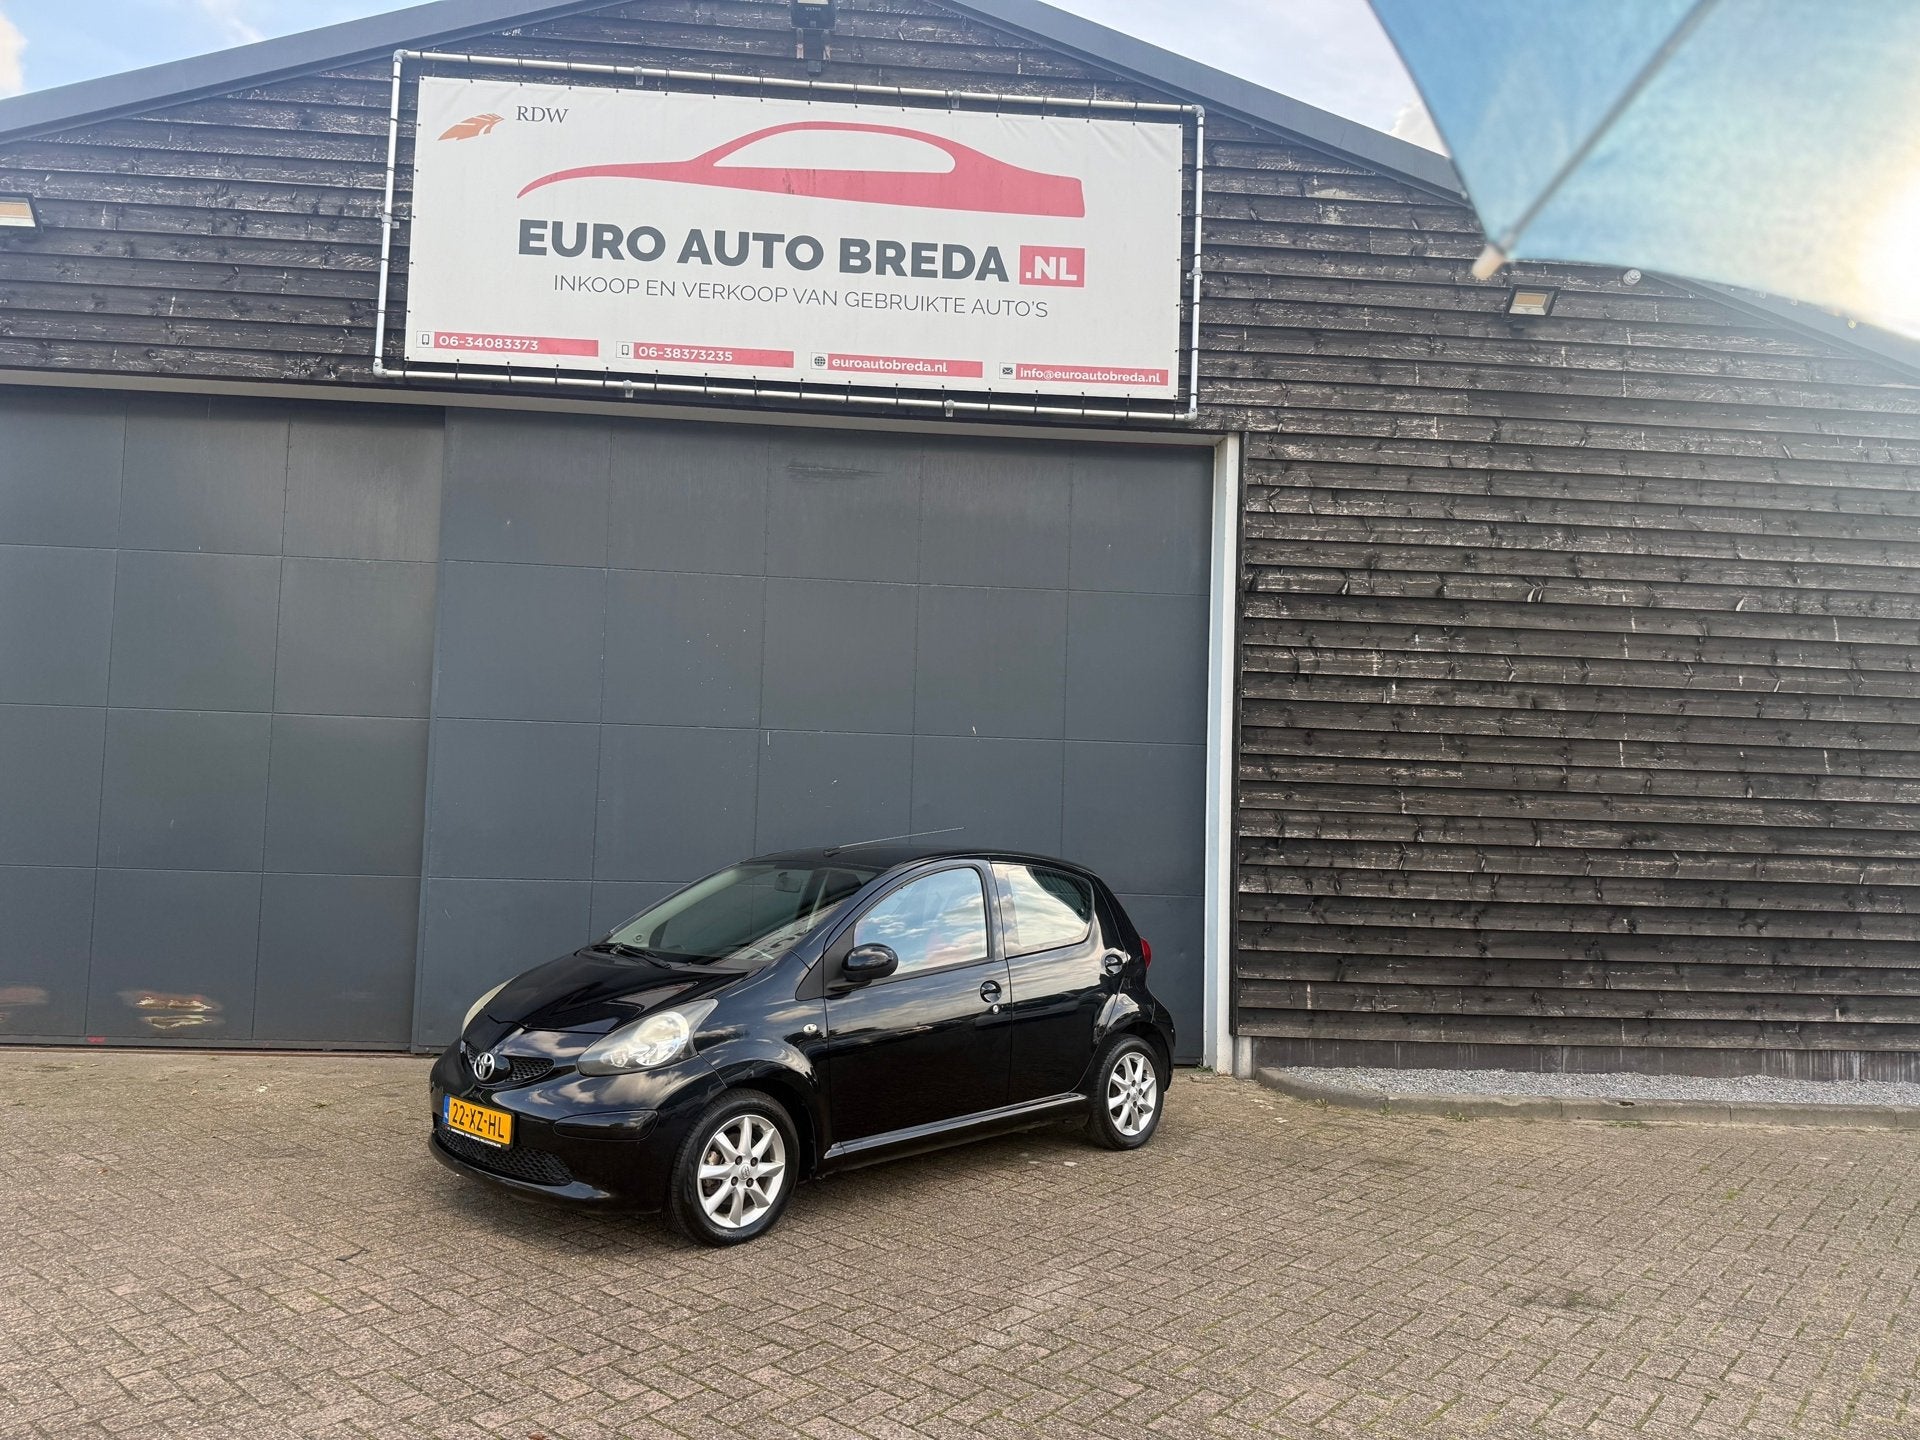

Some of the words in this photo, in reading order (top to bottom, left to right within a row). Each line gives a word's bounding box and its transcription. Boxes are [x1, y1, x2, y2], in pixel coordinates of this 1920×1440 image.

[516, 105, 569, 123] RDW
[518, 219, 666, 262] EURO
[677, 228, 824, 271] AUTO
[839, 237, 1009, 282] BREDA
[1025, 256, 1077, 281] .NL
[554, 275, 639, 294] INKOOP
[646, 280, 675, 297] EN
[682, 282, 787, 304] VERKOOP
[793, 288, 837, 306] VAN
[845, 291, 965, 314] GEBRUIKTE
[971, 299, 1048, 318] AUTO'S
[439, 335, 538, 351] 06-34083373
[639, 346, 733, 362] 06-38373235
[832, 357, 948, 374] euroautobreda.nl
[452, 1102, 504, 1139] 22-XZ-HL
